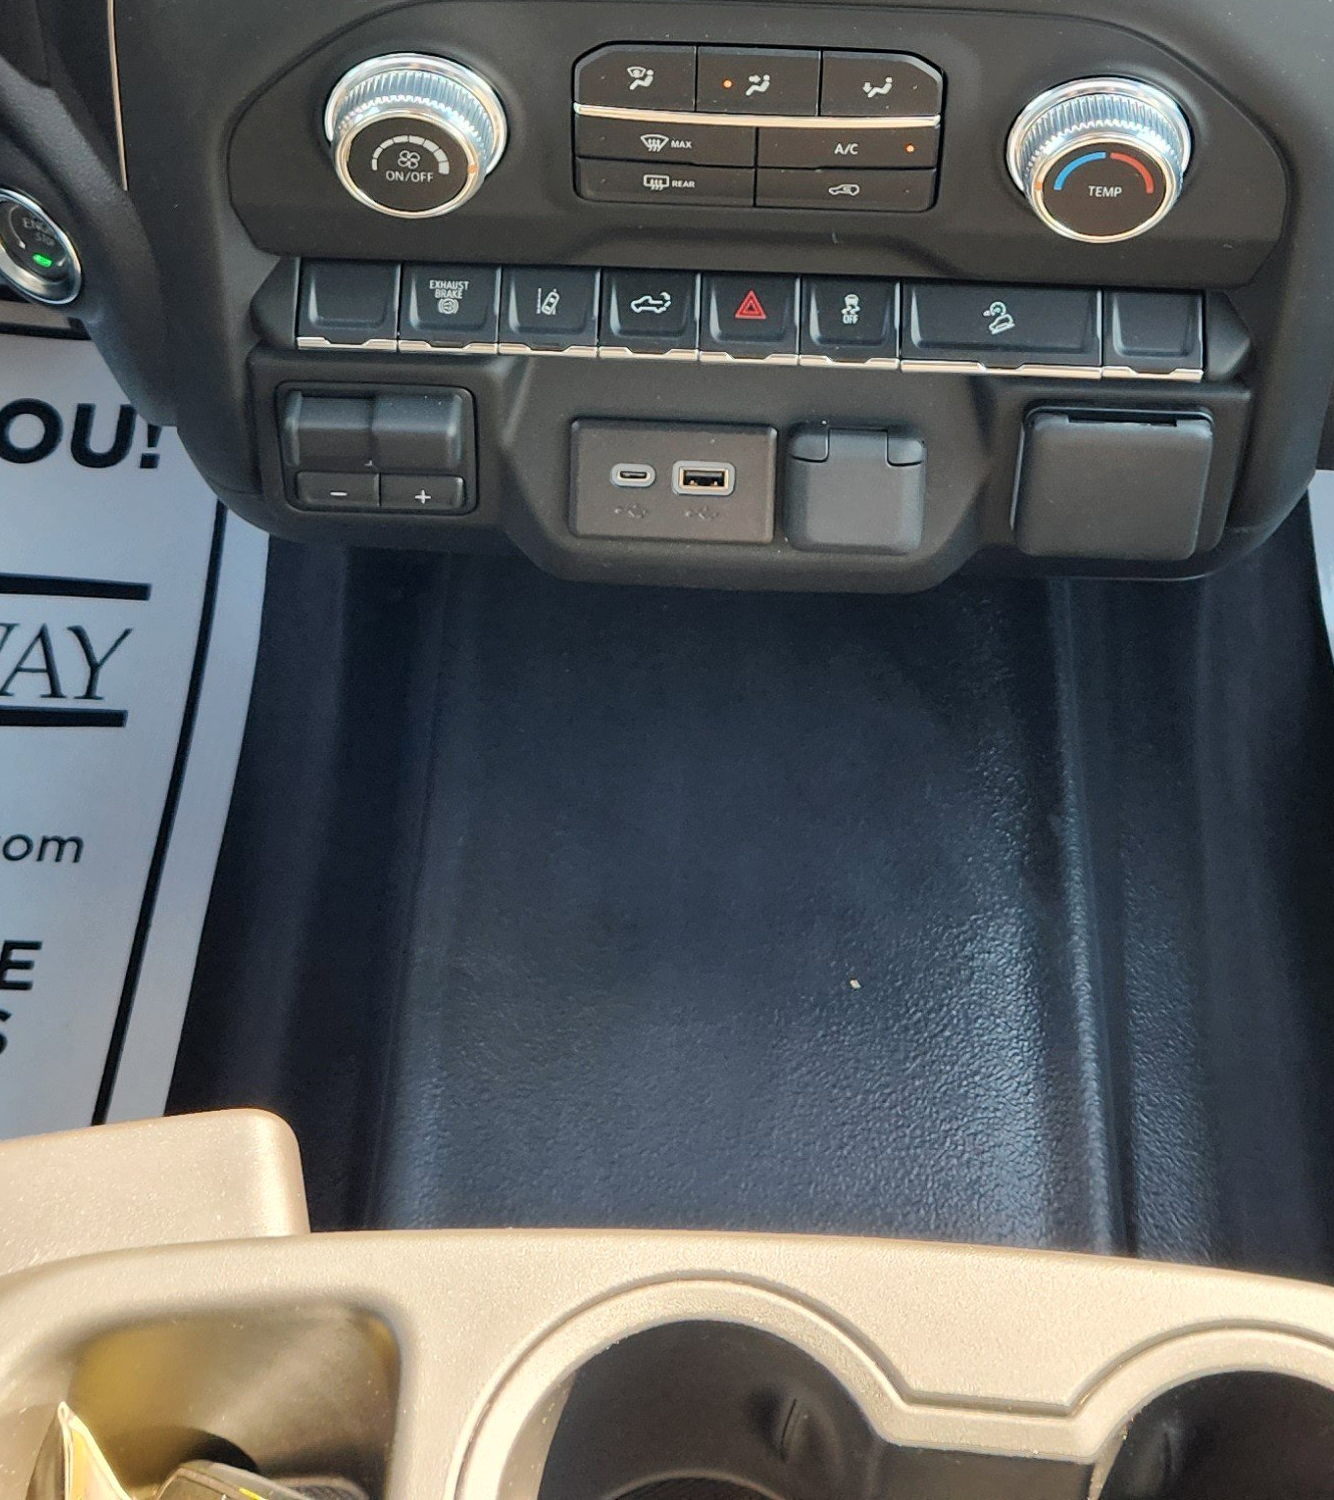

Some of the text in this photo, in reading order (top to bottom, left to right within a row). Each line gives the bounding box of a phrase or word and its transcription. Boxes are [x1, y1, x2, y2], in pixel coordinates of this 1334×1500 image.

[670, 139, 693, 150] MAX
[834, 143, 859, 156] A/C
[385, 170, 434, 184] ON/OFF
[671, 178, 695, 189] REAR
[1088, 185, 1123, 198] TEMP
[429, 279, 469, 291] EXHAUST
[434, 288, 463, 299] BRAKE
[842, 314, 859, 325] OFF
